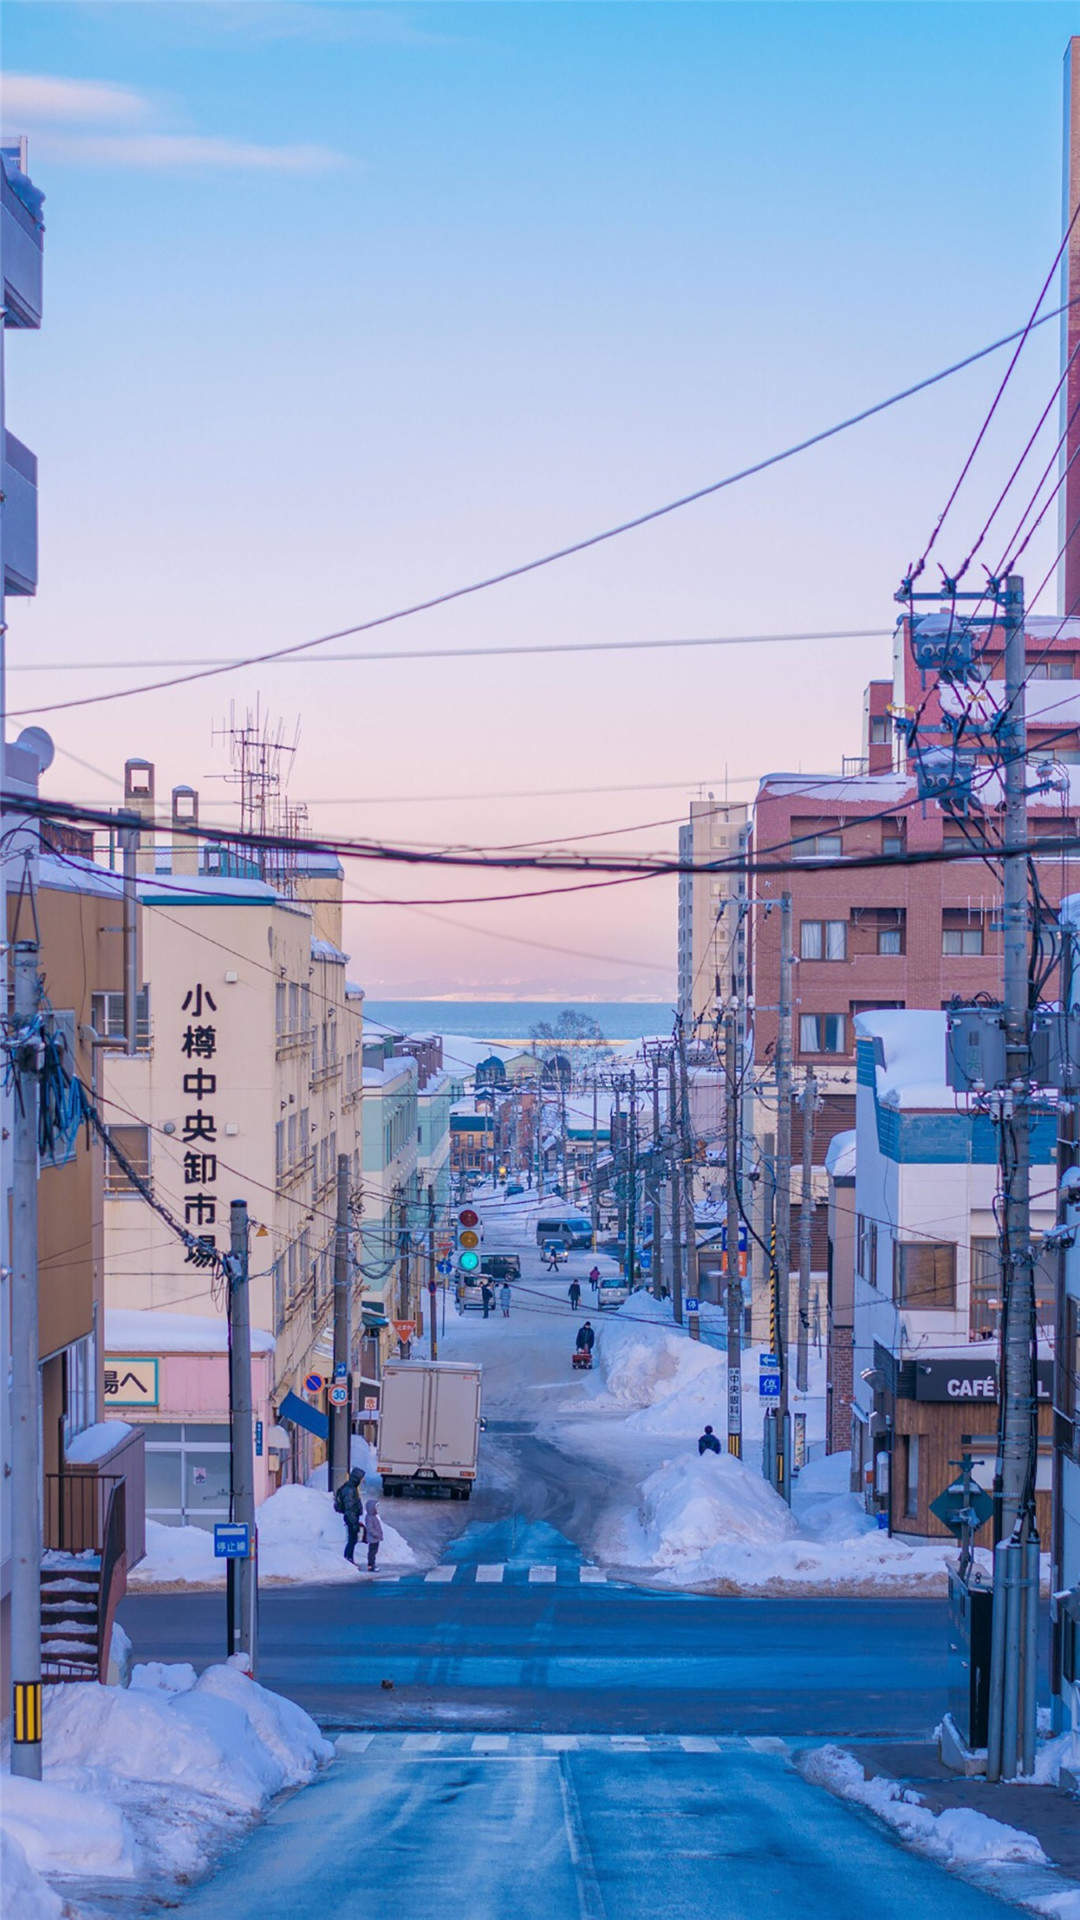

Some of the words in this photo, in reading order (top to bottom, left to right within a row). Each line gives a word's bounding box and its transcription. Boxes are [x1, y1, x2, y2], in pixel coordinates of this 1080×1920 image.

[763, 1378, 777, 1393] 停
[947, 1376, 995, 1397] CAFÉ
[332, 1389, 346, 1400] 30
